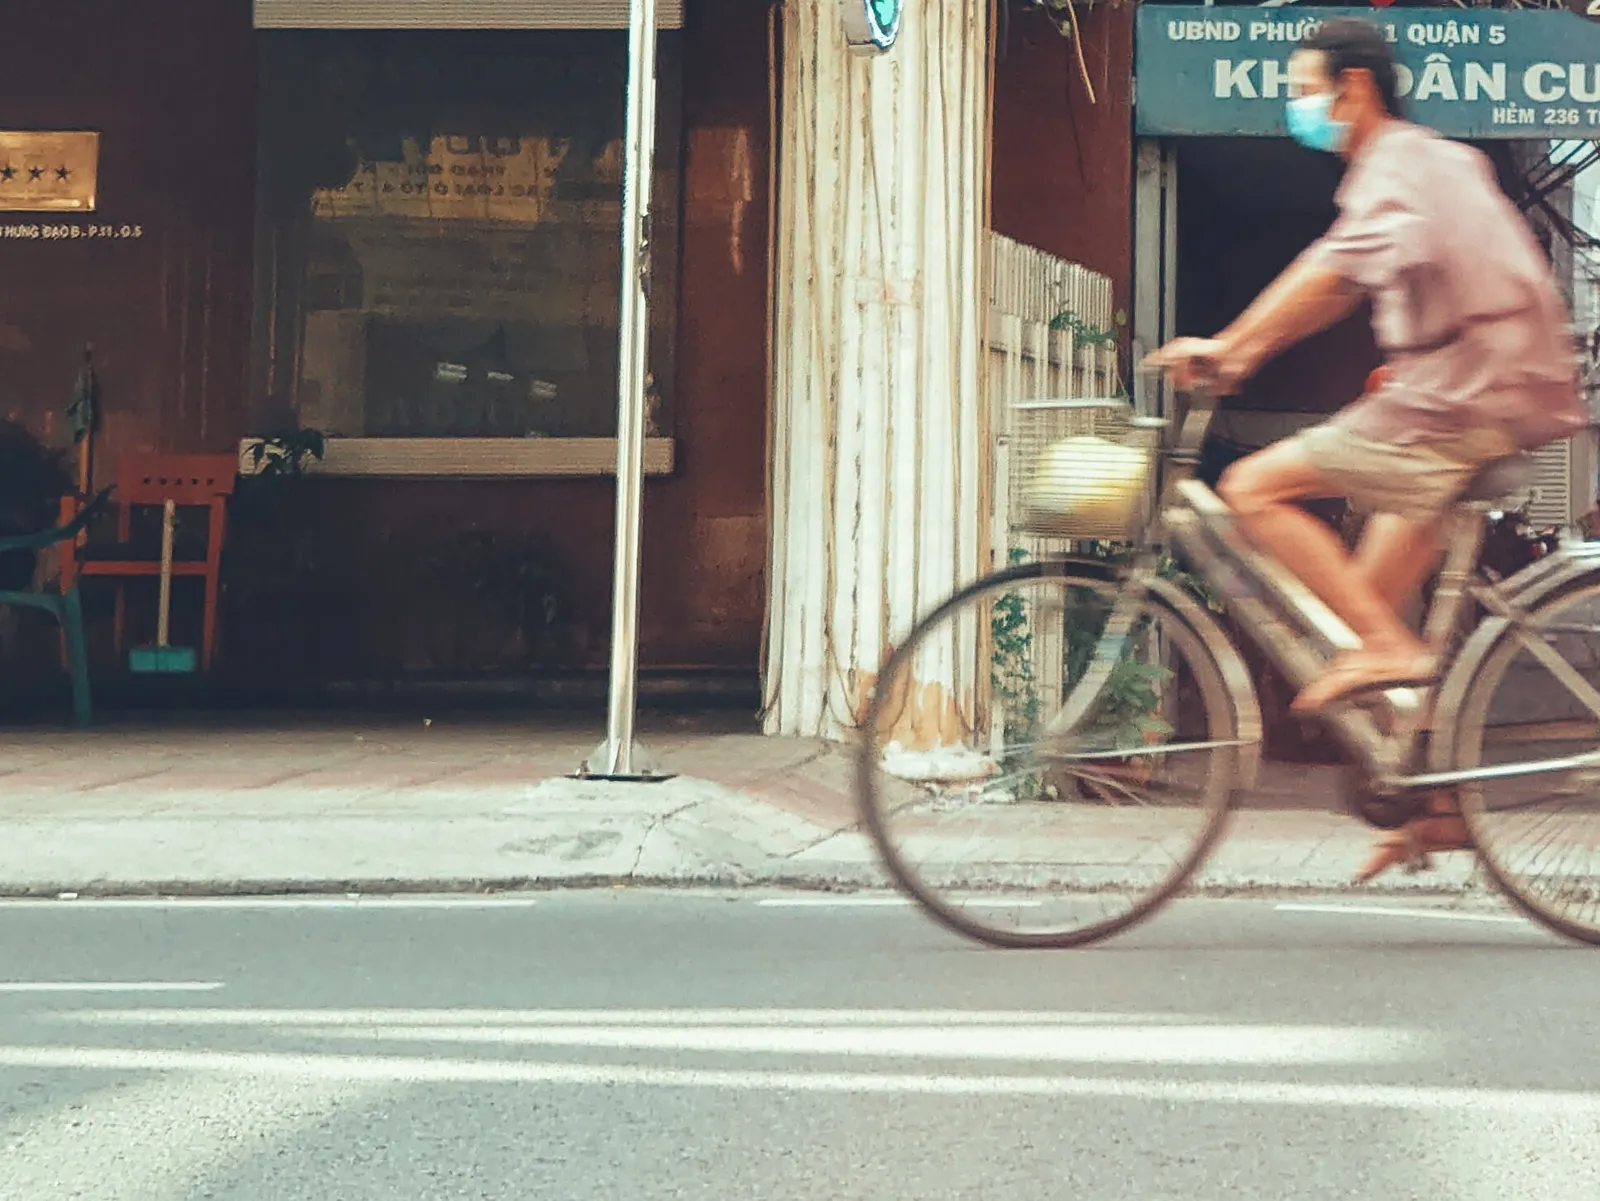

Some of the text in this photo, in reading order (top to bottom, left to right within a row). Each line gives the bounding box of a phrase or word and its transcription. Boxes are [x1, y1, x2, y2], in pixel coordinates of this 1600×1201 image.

[1168, 20, 1241, 41] UBND
[1250, 17, 1323, 42] PHƯỜ
[1407, 19, 1480, 48] QUẬN
[1488, 25, 1506, 44] 5
[1214, 59, 1292, 99] KH
[1543, 108, 1580, 125] 236
